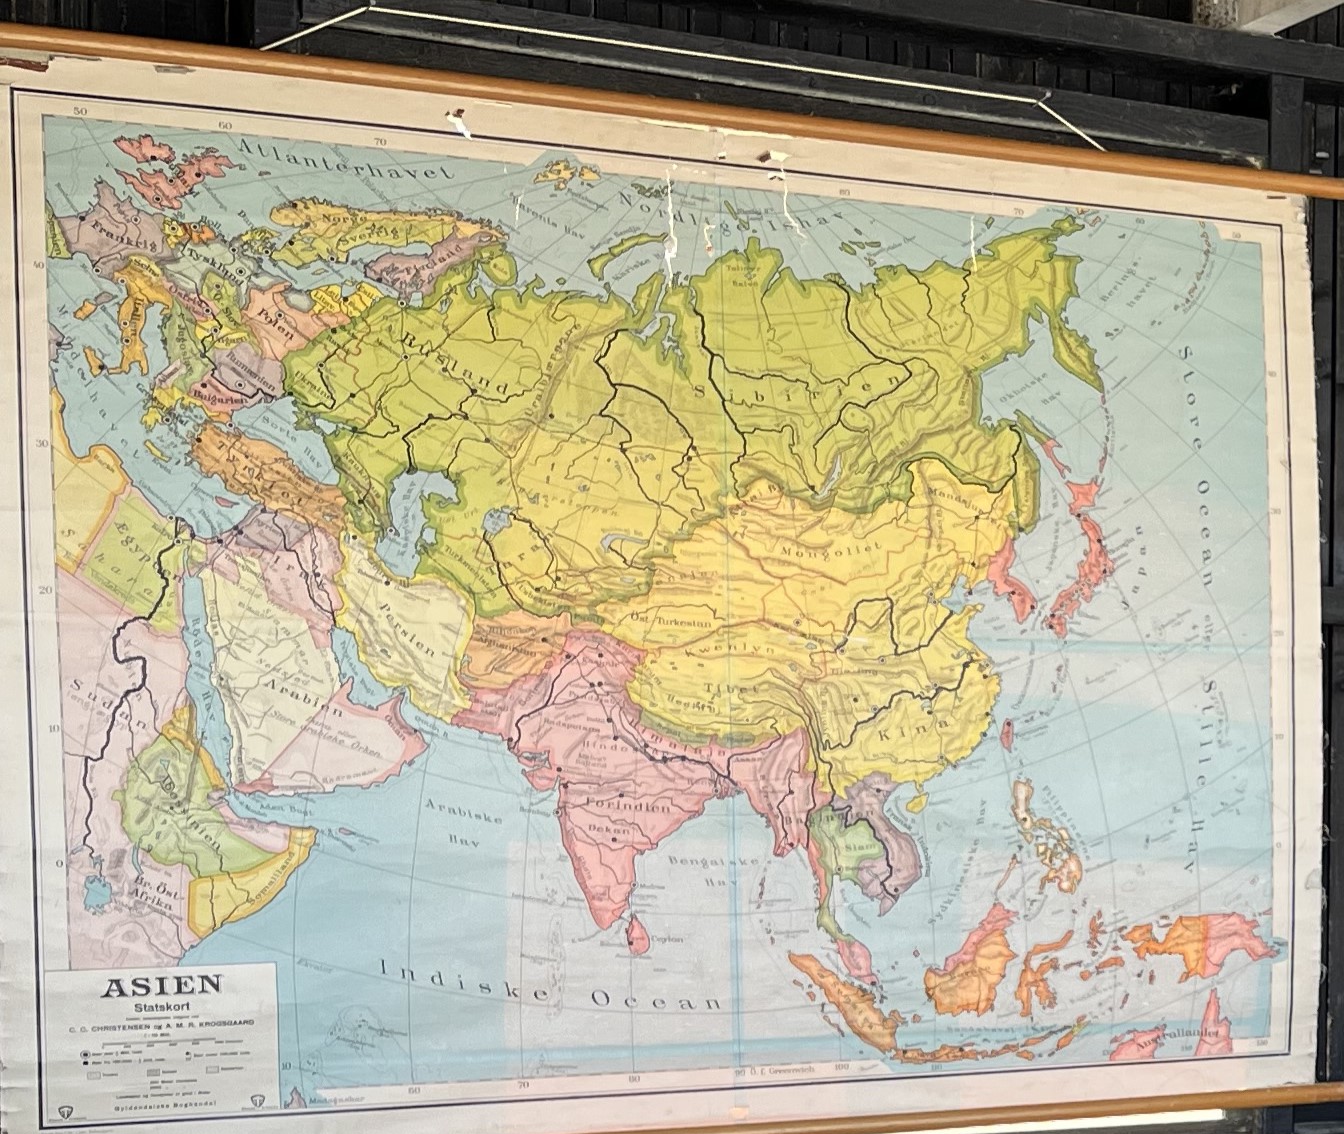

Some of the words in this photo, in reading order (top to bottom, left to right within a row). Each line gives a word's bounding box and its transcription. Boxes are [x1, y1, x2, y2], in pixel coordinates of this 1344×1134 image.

[237, 136, 456, 181] Atlanterhavet
[90, 218, 160, 254] Frankrig
[257, 306, 295, 343] Polen
[694, 373, 900, 402] Sibirien
[1197, 479, 1214, 588] Ocean
[380, 602, 436, 658] Persien
[264, 677, 344, 719] Arabien
[878, 719, 952, 743] Kina
[425, 798, 503, 825] Arabiske
[100, 973, 224, 999] ASIEN
[380, 958, 549, 1002] Indiske
[590, 988, 721, 1012] Ocean
[134, 1001, 191, 1014] Statskort
